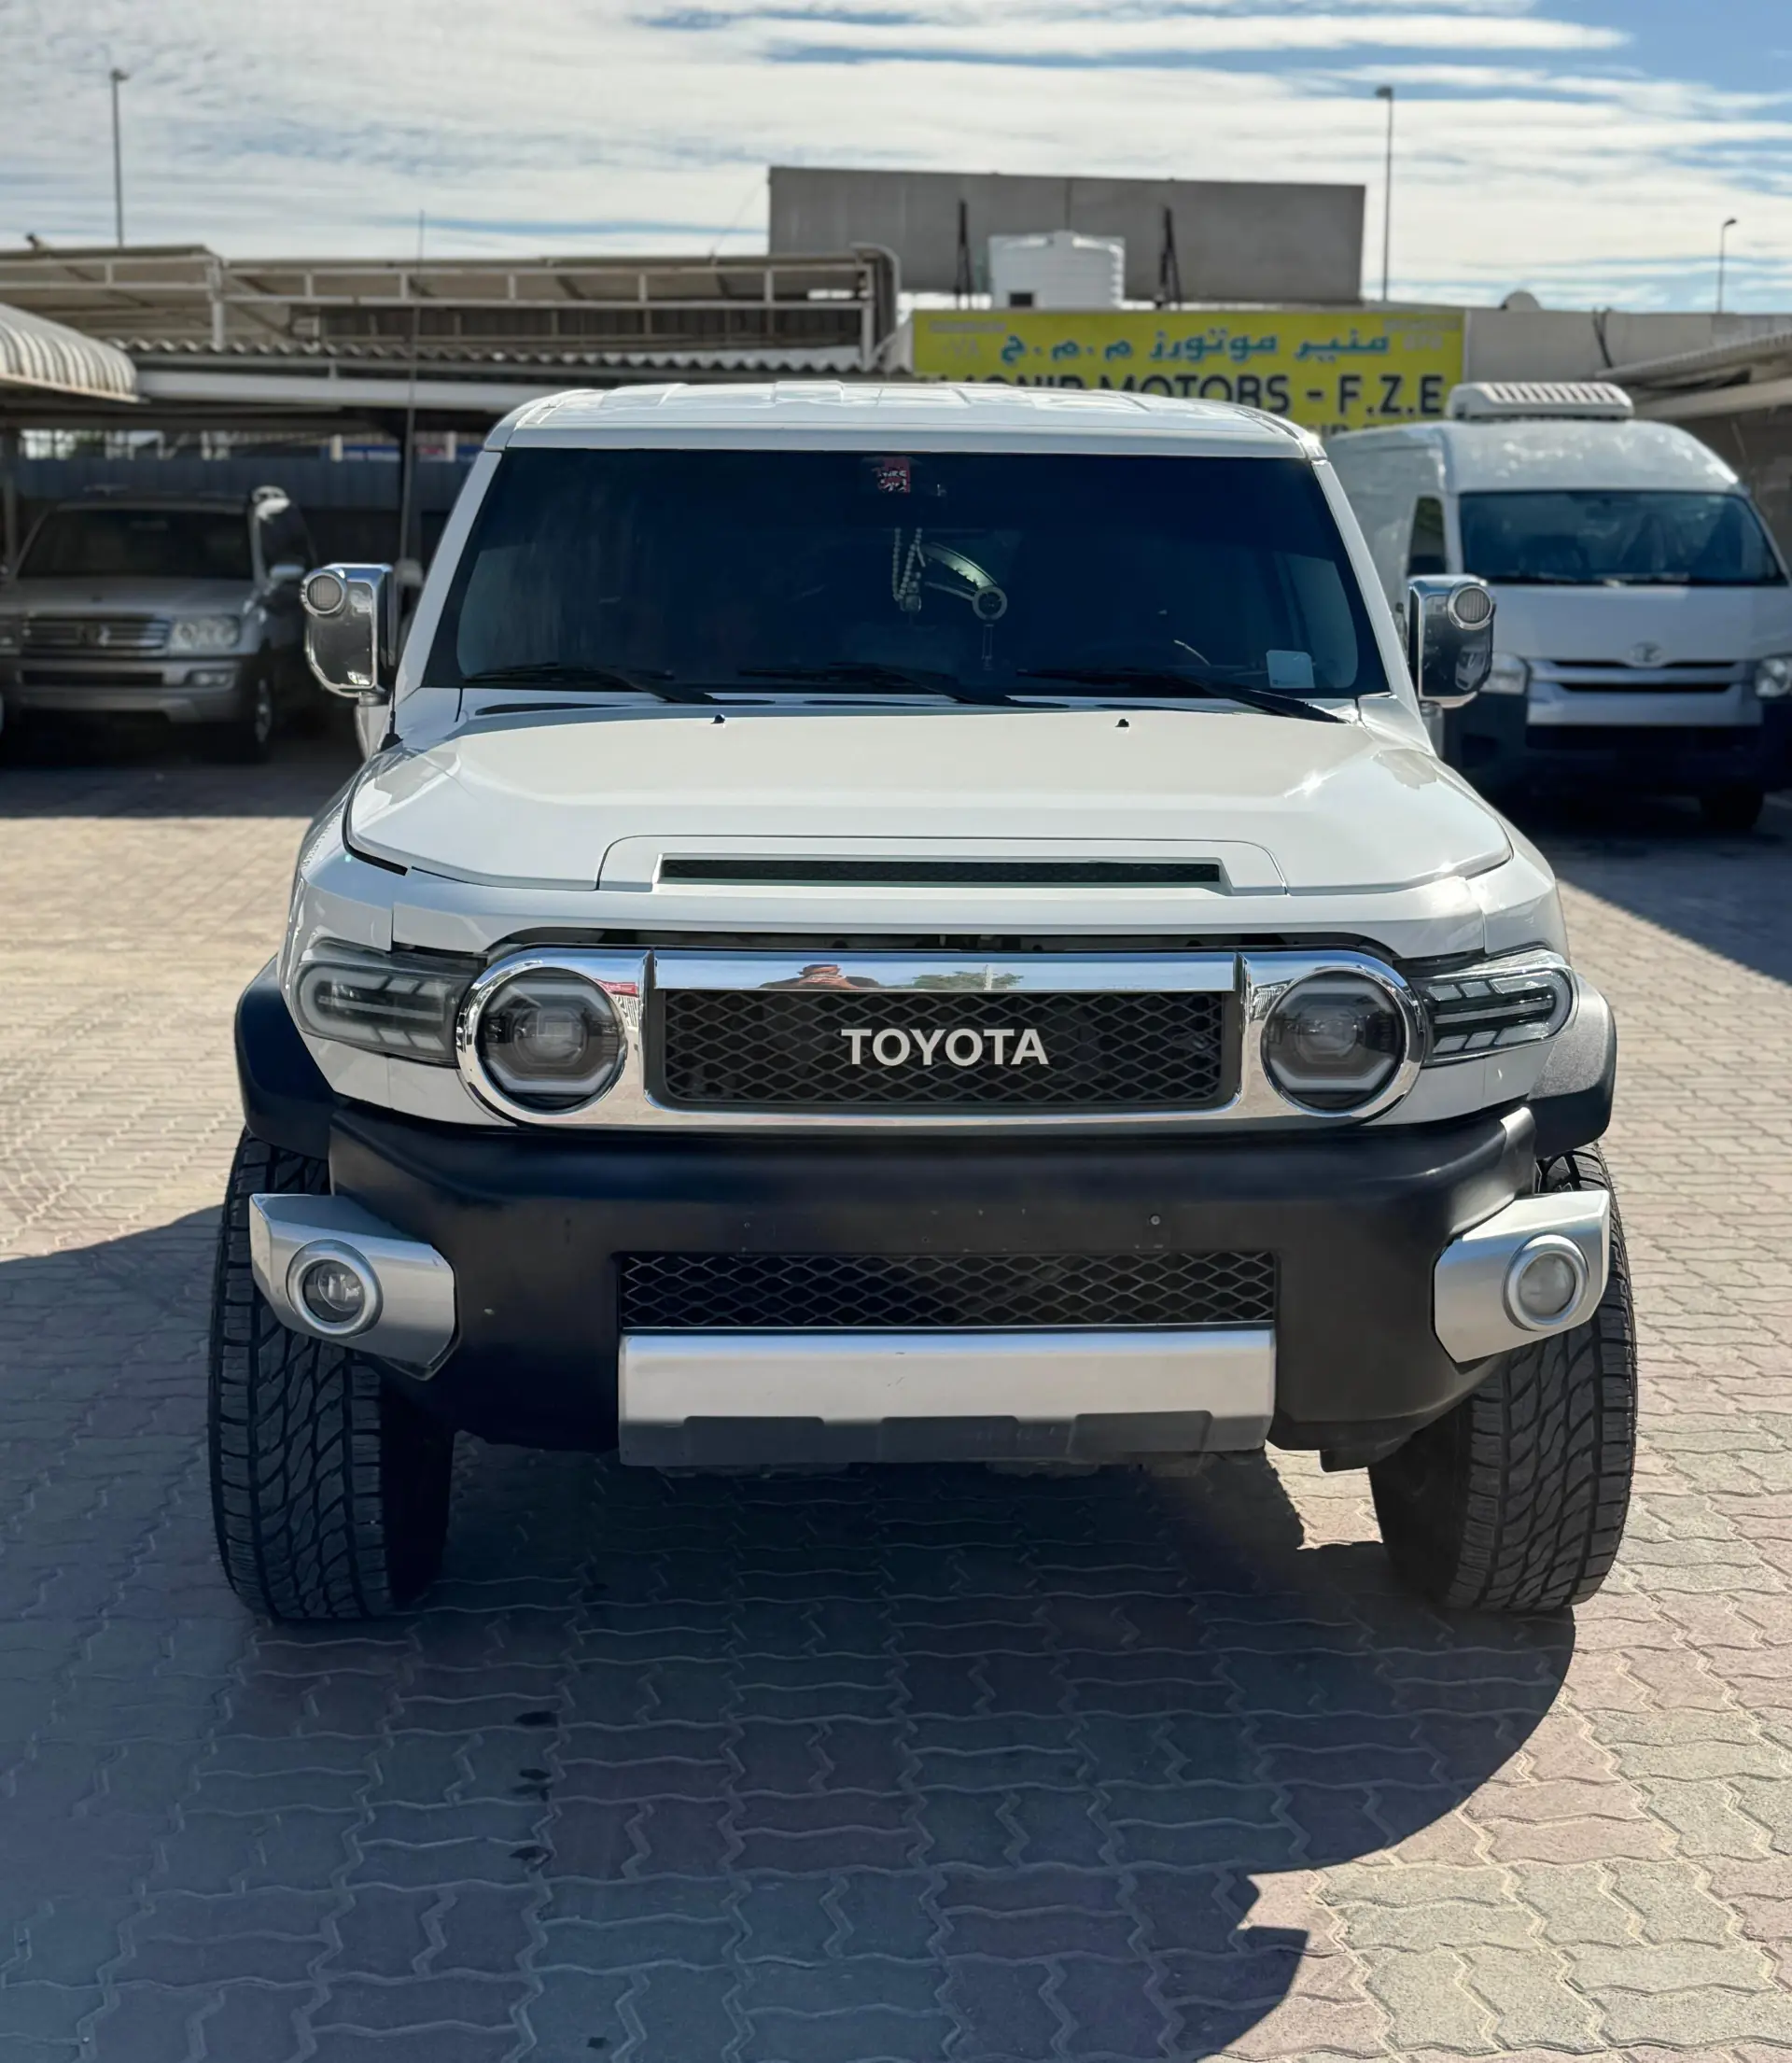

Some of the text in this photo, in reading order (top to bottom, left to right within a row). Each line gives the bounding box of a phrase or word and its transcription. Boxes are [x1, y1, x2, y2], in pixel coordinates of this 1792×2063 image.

[1149, 329, 1278, 363] موتورز
[1294, 329, 1390, 362] منير
[841, 1028, 1049, 1066] TOYOTA
